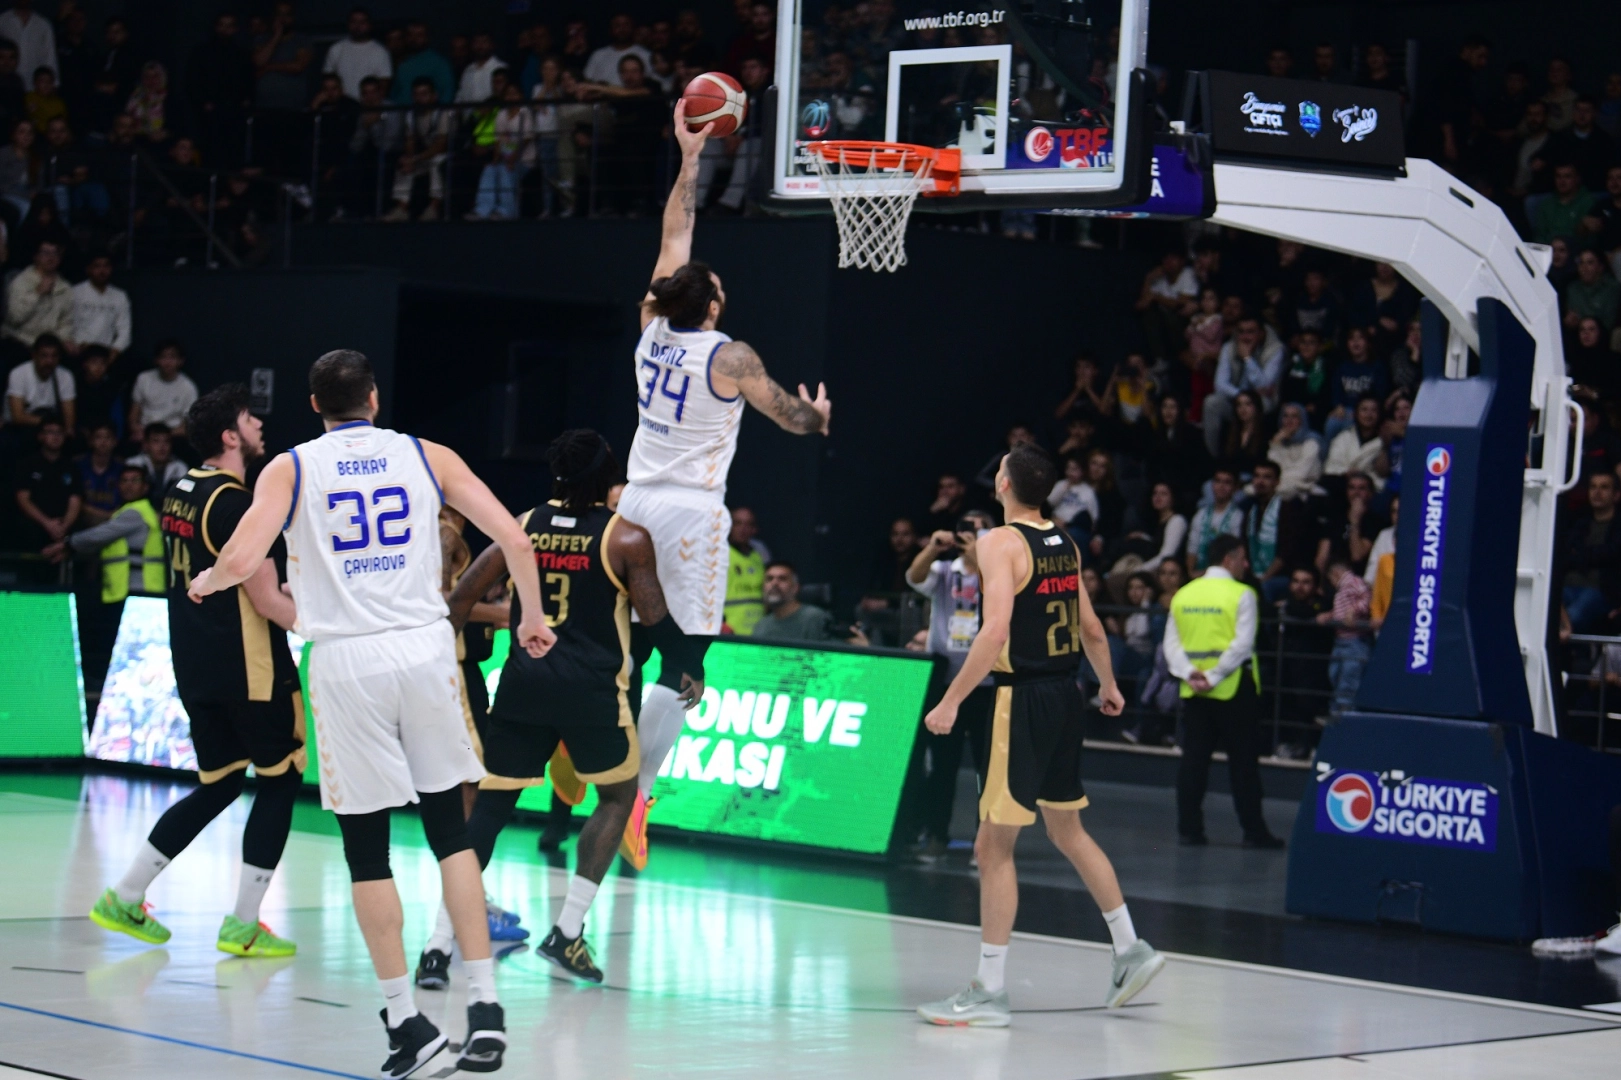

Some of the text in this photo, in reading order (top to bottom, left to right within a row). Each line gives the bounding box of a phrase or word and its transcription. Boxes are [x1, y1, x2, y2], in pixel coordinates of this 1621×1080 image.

[904, 9, 1006, 31] www.tbf.org.tr
[1055, 127, 1109, 158] TBF
[639, 358, 691, 423] 34
[337, 457, 388, 477] BERKAY
[325, 484, 413, 554] 32
[528, 532, 594, 553] COFFEY
[344, 554, 406, 579] ÇAYIROVA
[543, 571, 571, 628] 3
[683, 686, 868, 748] ONU VE
